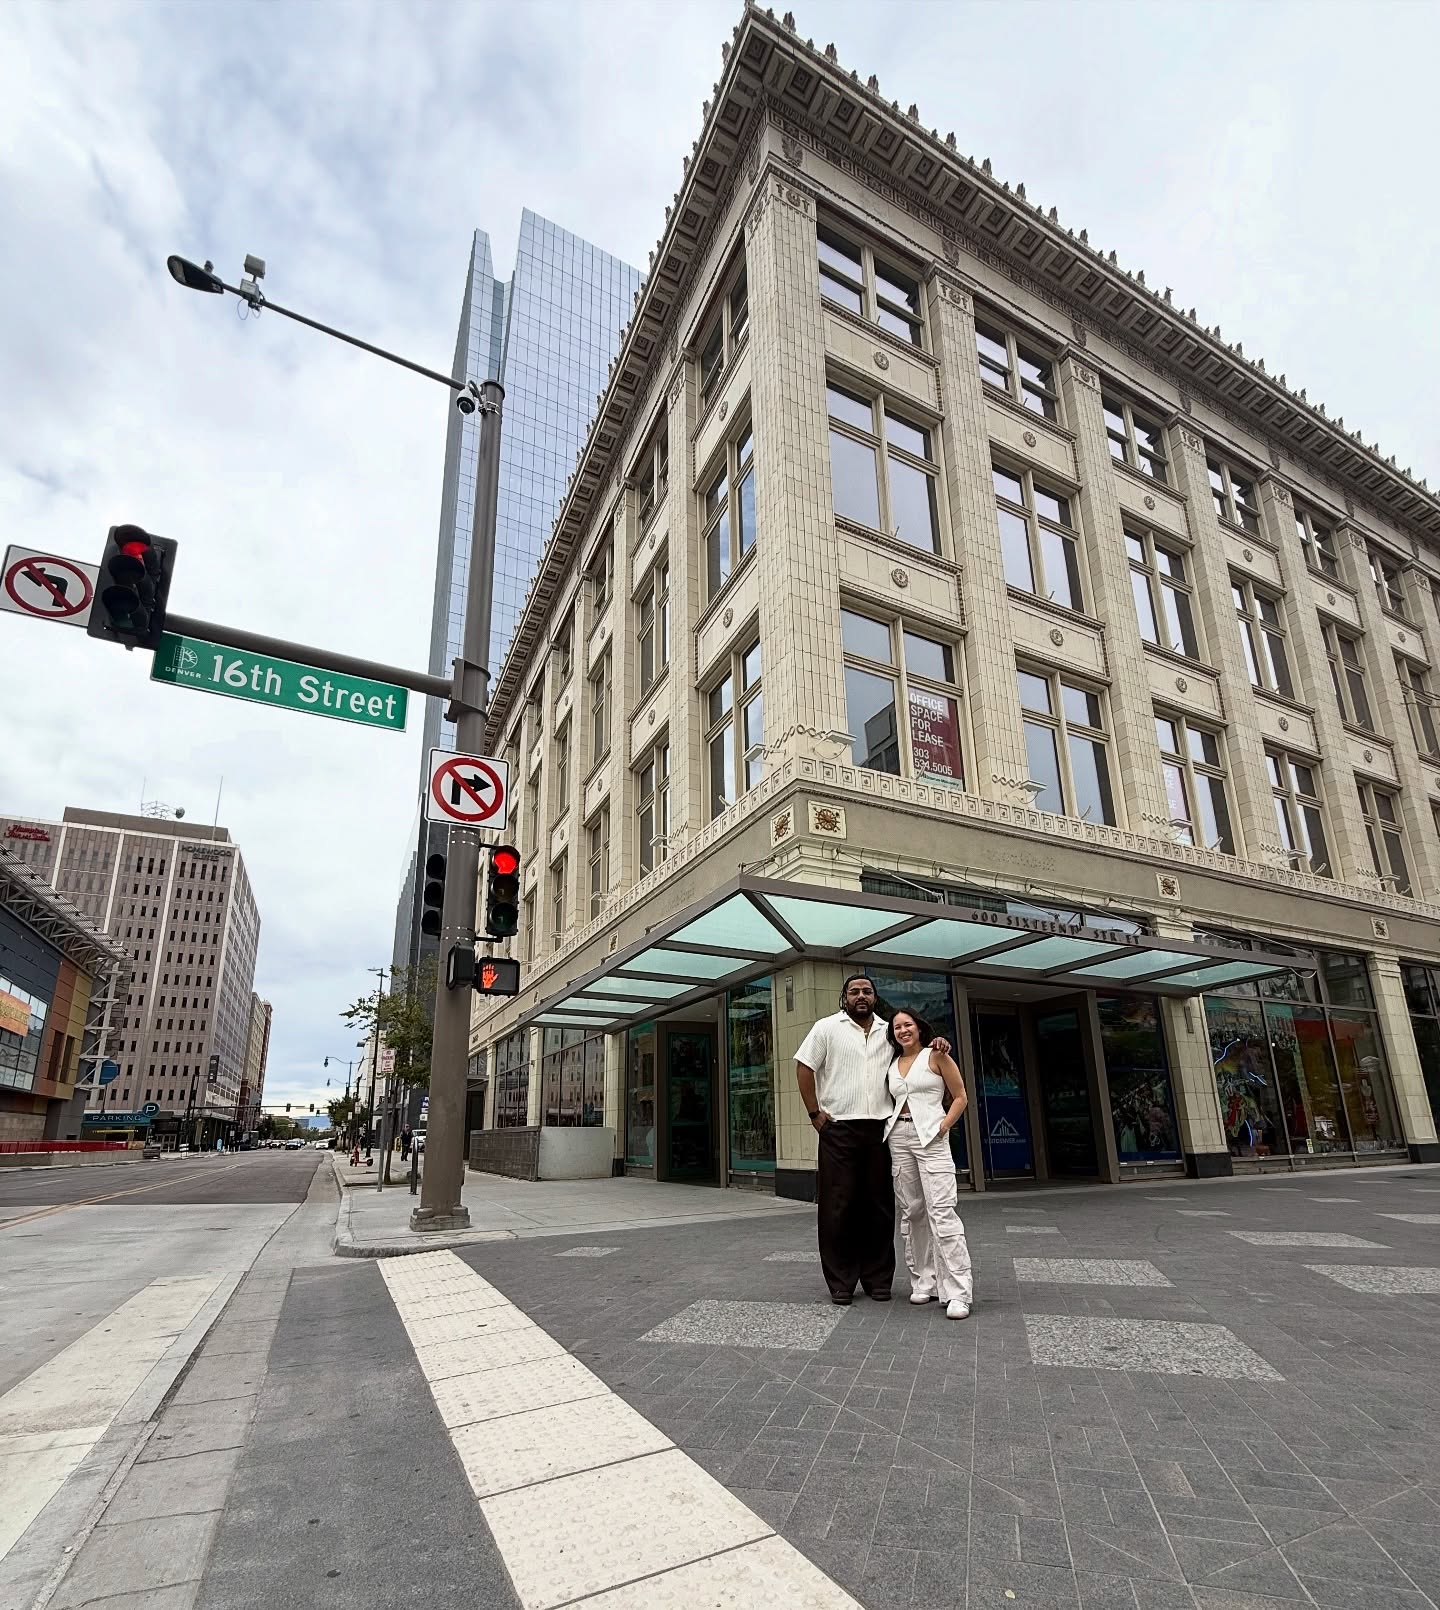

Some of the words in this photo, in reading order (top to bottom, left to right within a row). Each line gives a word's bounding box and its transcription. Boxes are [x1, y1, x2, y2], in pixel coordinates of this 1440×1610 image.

[165, 666, 202, 679] DENVER
[211, 654, 282, 697] 16th
[297, 675, 397, 721] Street
[909, 692, 944, 713] OFFICE
[910, 704, 944, 724] SPACE
[911, 717, 932, 733] FOR
[912, 729, 944, 748] LEASE
[913, 746, 930, 760] 303
[181, 844, 232, 857] HOMEWOOD
[971, 911, 998, 924] 600
[145, 1105, 156, 1114] P
